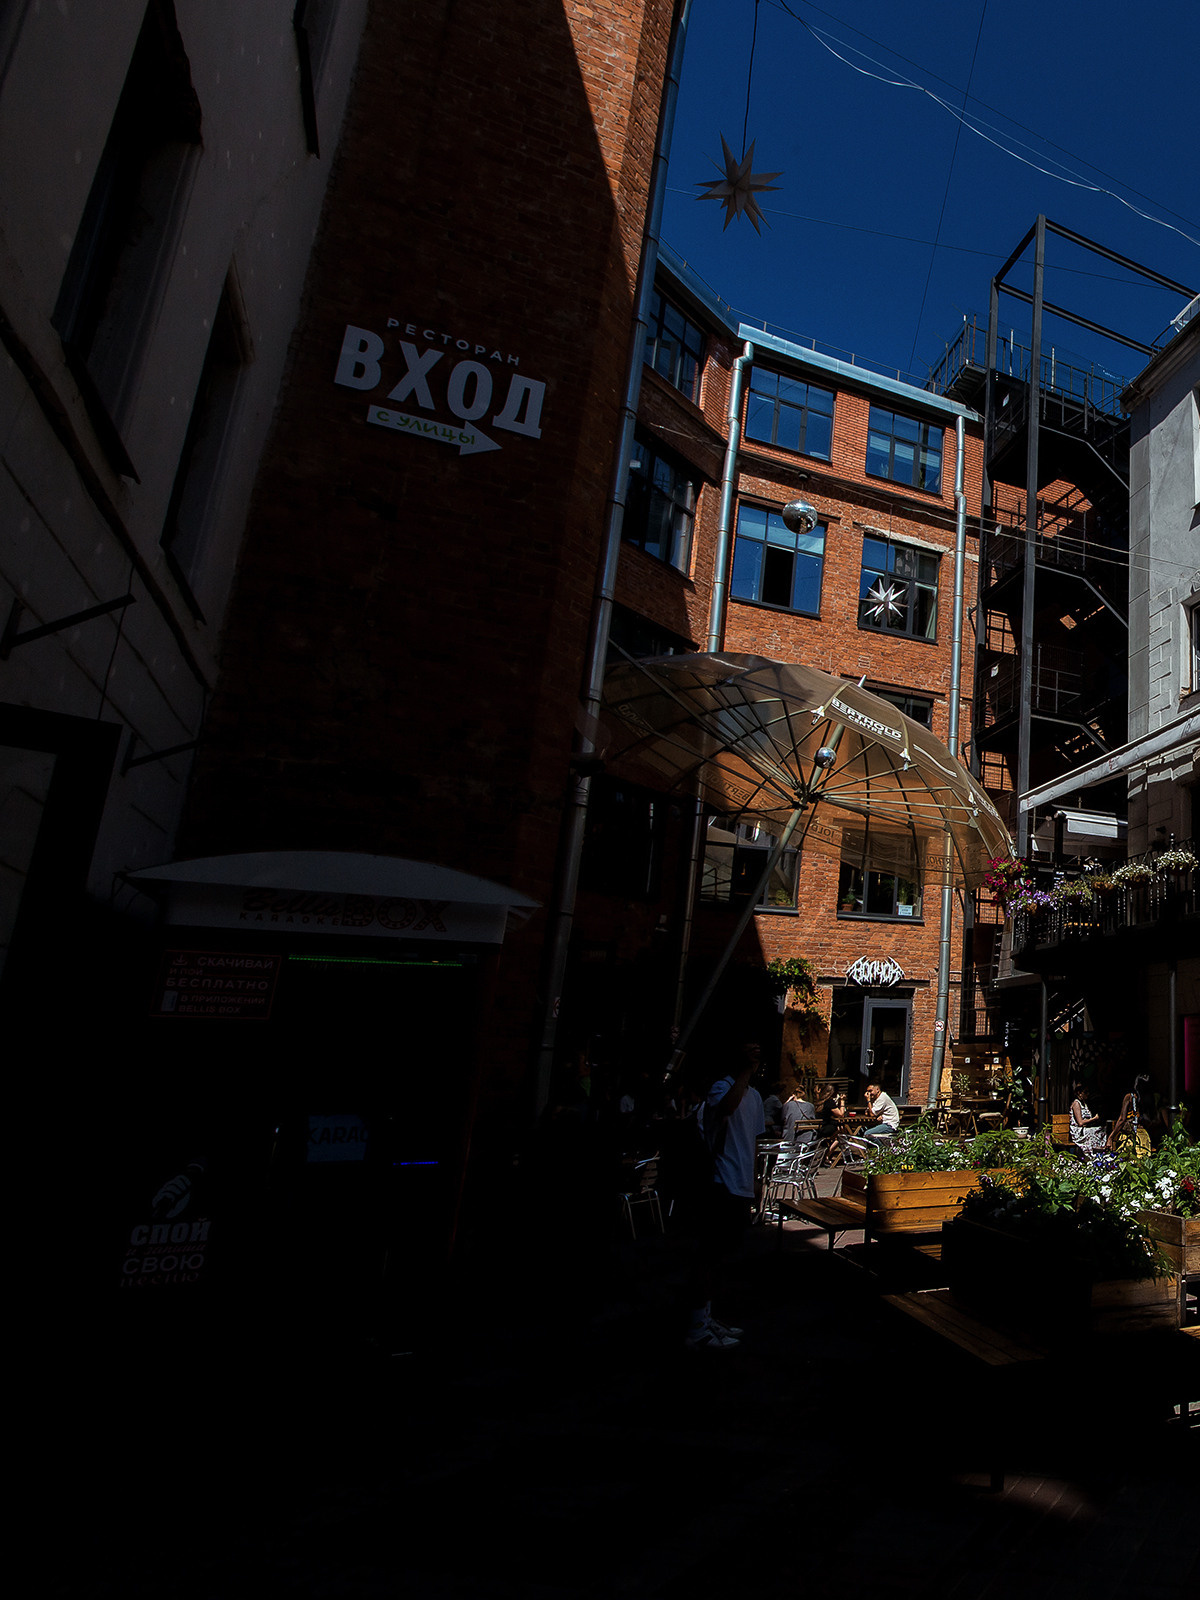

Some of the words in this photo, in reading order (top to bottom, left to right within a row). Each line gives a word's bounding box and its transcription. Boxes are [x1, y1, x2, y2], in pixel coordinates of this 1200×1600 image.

[387, 317, 520, 366] РЕСТОРАН
[334, 324, 547, 440] ВХОД
[397, 413, 476, 445] УЛИЦЫ
[832, 697, 903, 740] BERTHOLD
[848, 715, 884, 736] CENTRE
[240, 911, 341, 927] KARAOKE
[342, 894, 450, 932] BOX
[166, 978, 269, 991] БЕСПЛАТНО
[130, 1216, 213, 1248] СПОЙ
[122, 1253, 205, 1275] СВОЮ
